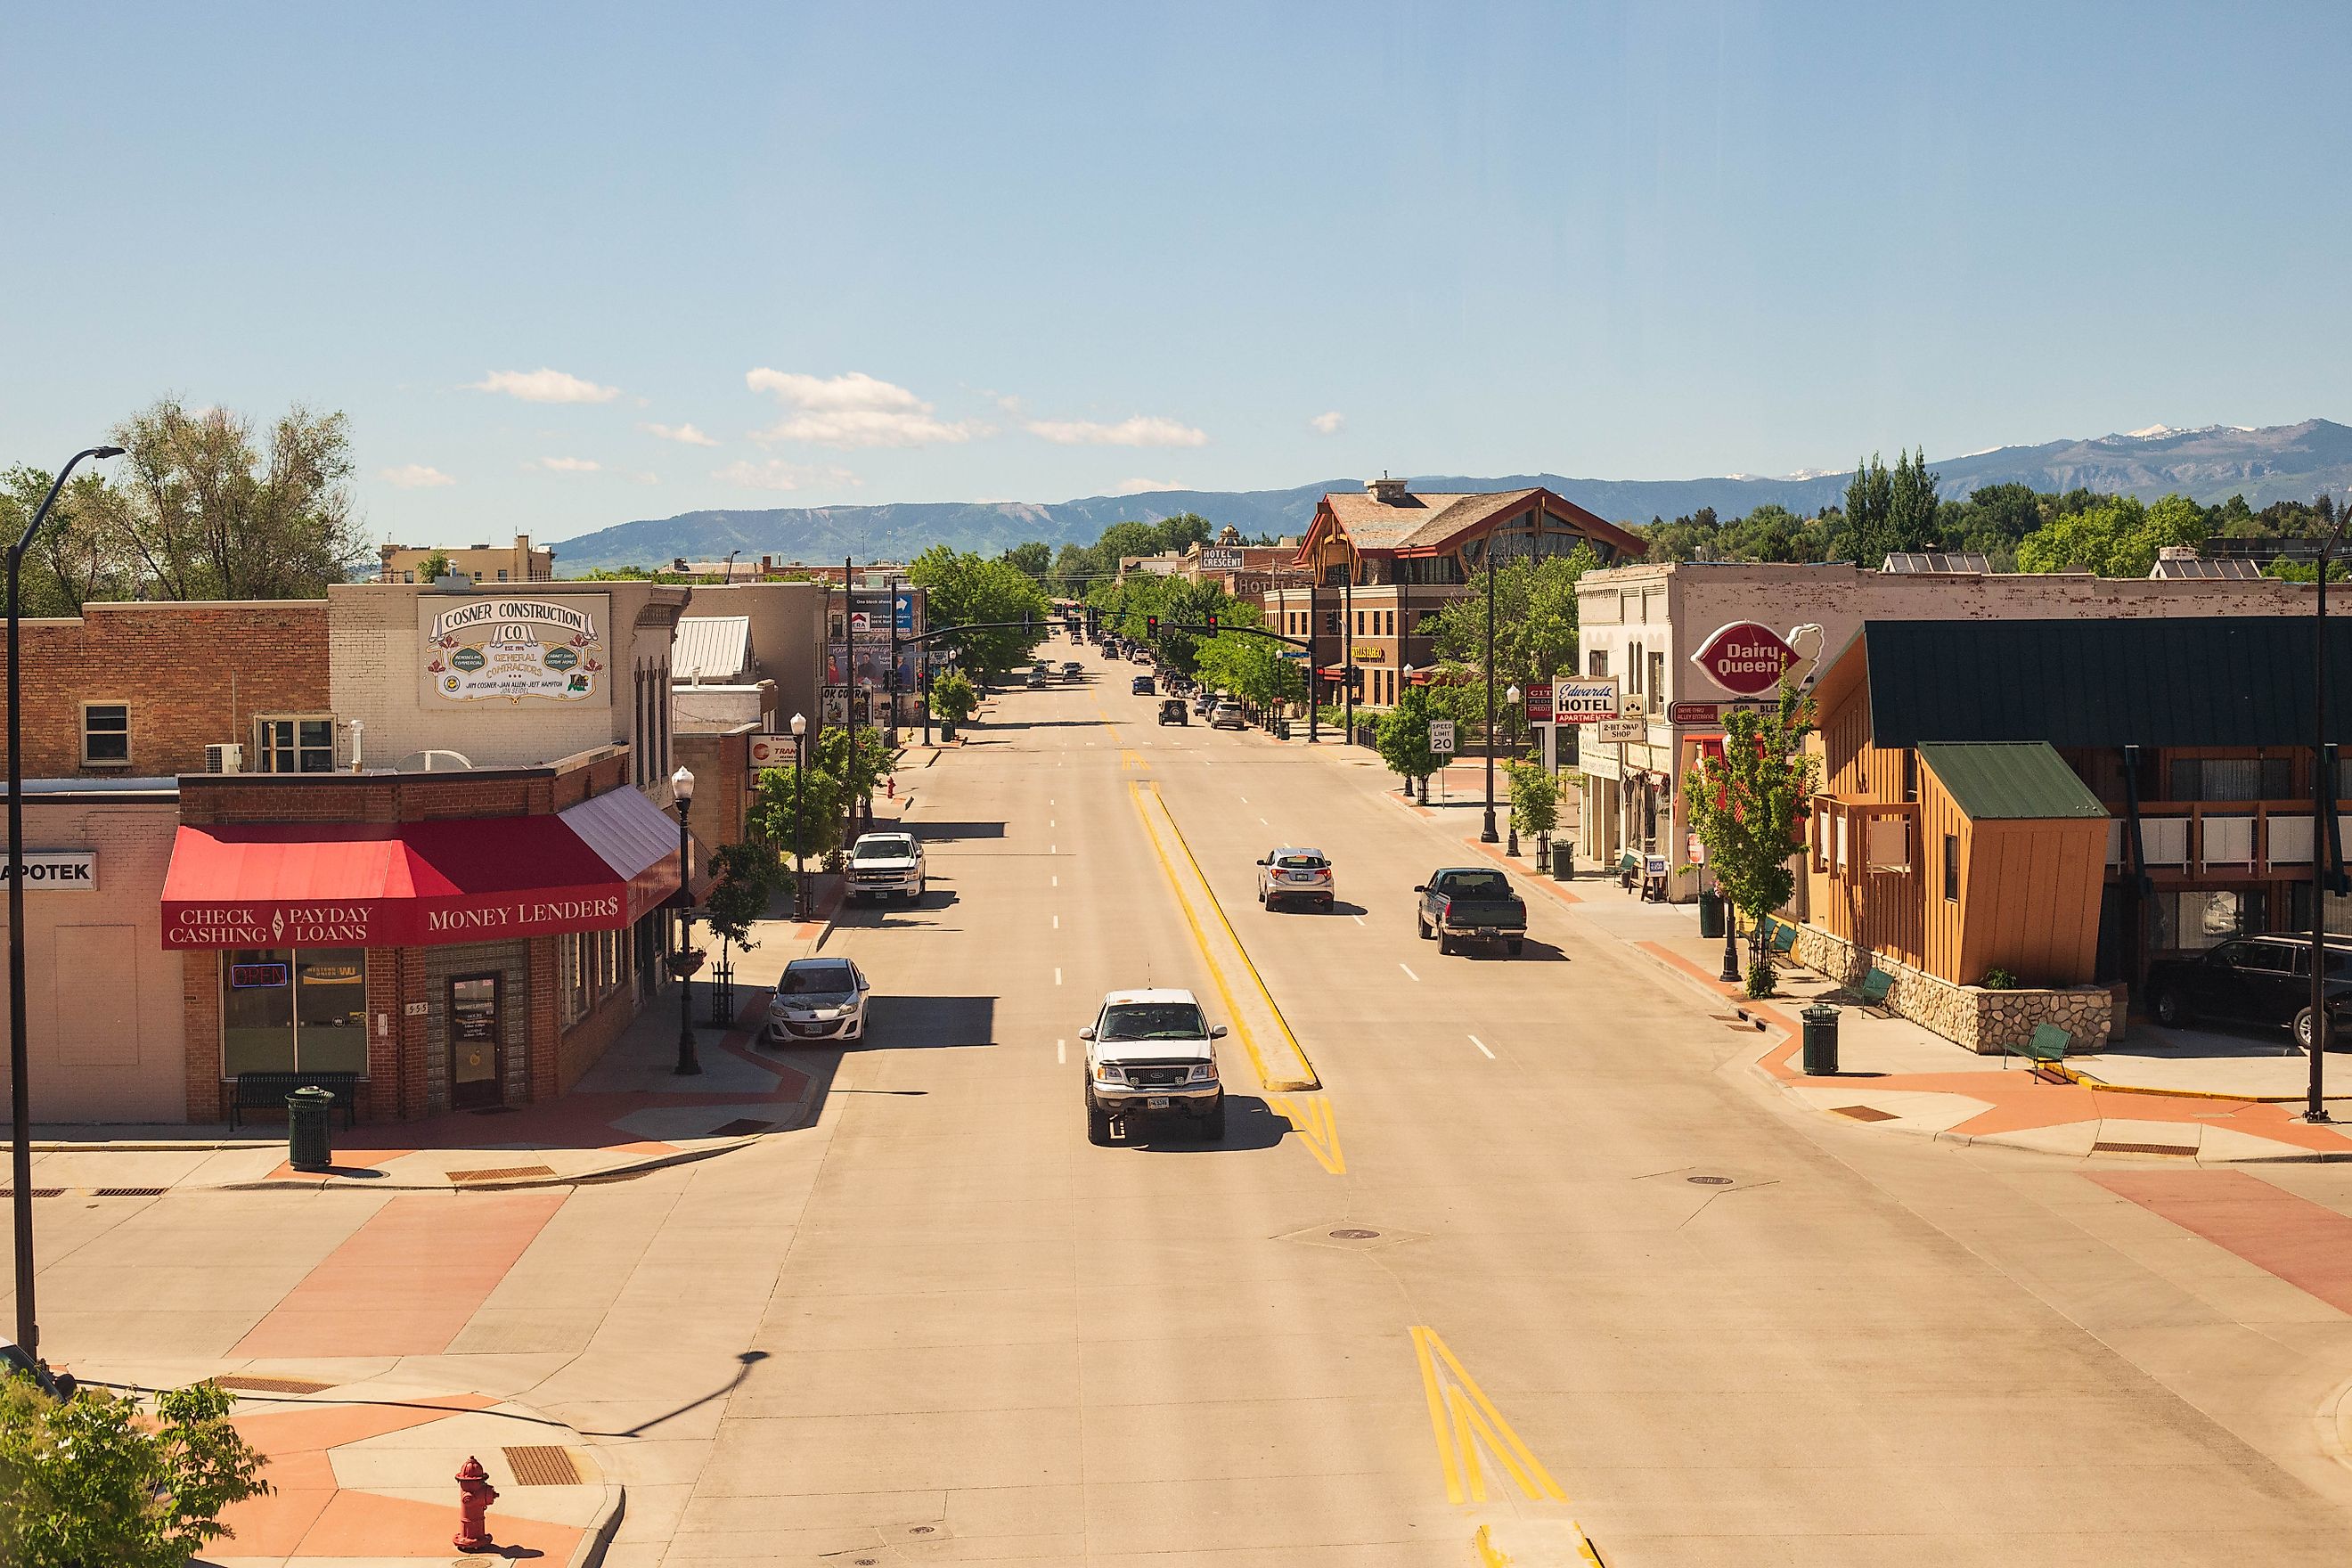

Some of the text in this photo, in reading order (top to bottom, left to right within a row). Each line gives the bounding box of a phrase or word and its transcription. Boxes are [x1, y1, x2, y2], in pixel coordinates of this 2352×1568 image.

[1204, 550, 1231, 558] HOTEL
[1204, 558, 1241, 567] CRESCENT
[445, 603, 582, 628] COSNER CONSTRUCTION
[505, 625, 524, 640] CO.
[494, 653, 536, 662] GENERAL
[1367, 647, 1382, 658] FARGO
[1727, 642, 1778, 659] Dairy
[486, 663, 543, 678] CONTRACTORS
[1718, 659, 1778, 676] Queen
[824, 689, 836, 698] OK
[1559, 683, 1613, 699] Edwards
[1559, 699, 1613, 711] HOTEL
[1760, 705, 1780, 713] BLES
[1559, 714, 1613, 722] APARTMENTS
[1433, 739, 1452, 748] 20
[180, 909, 255, 924] CHECK
[289, 907, 373, 923] PAYDAY
[429, 907, 511, 931] MONEY
[519, 896, 618, 923] LENDER$
[169, 927, 267, 943] CASHING
[296, 925, 367, 942] LOANS
[233, 967, 284, 984] OPEN
